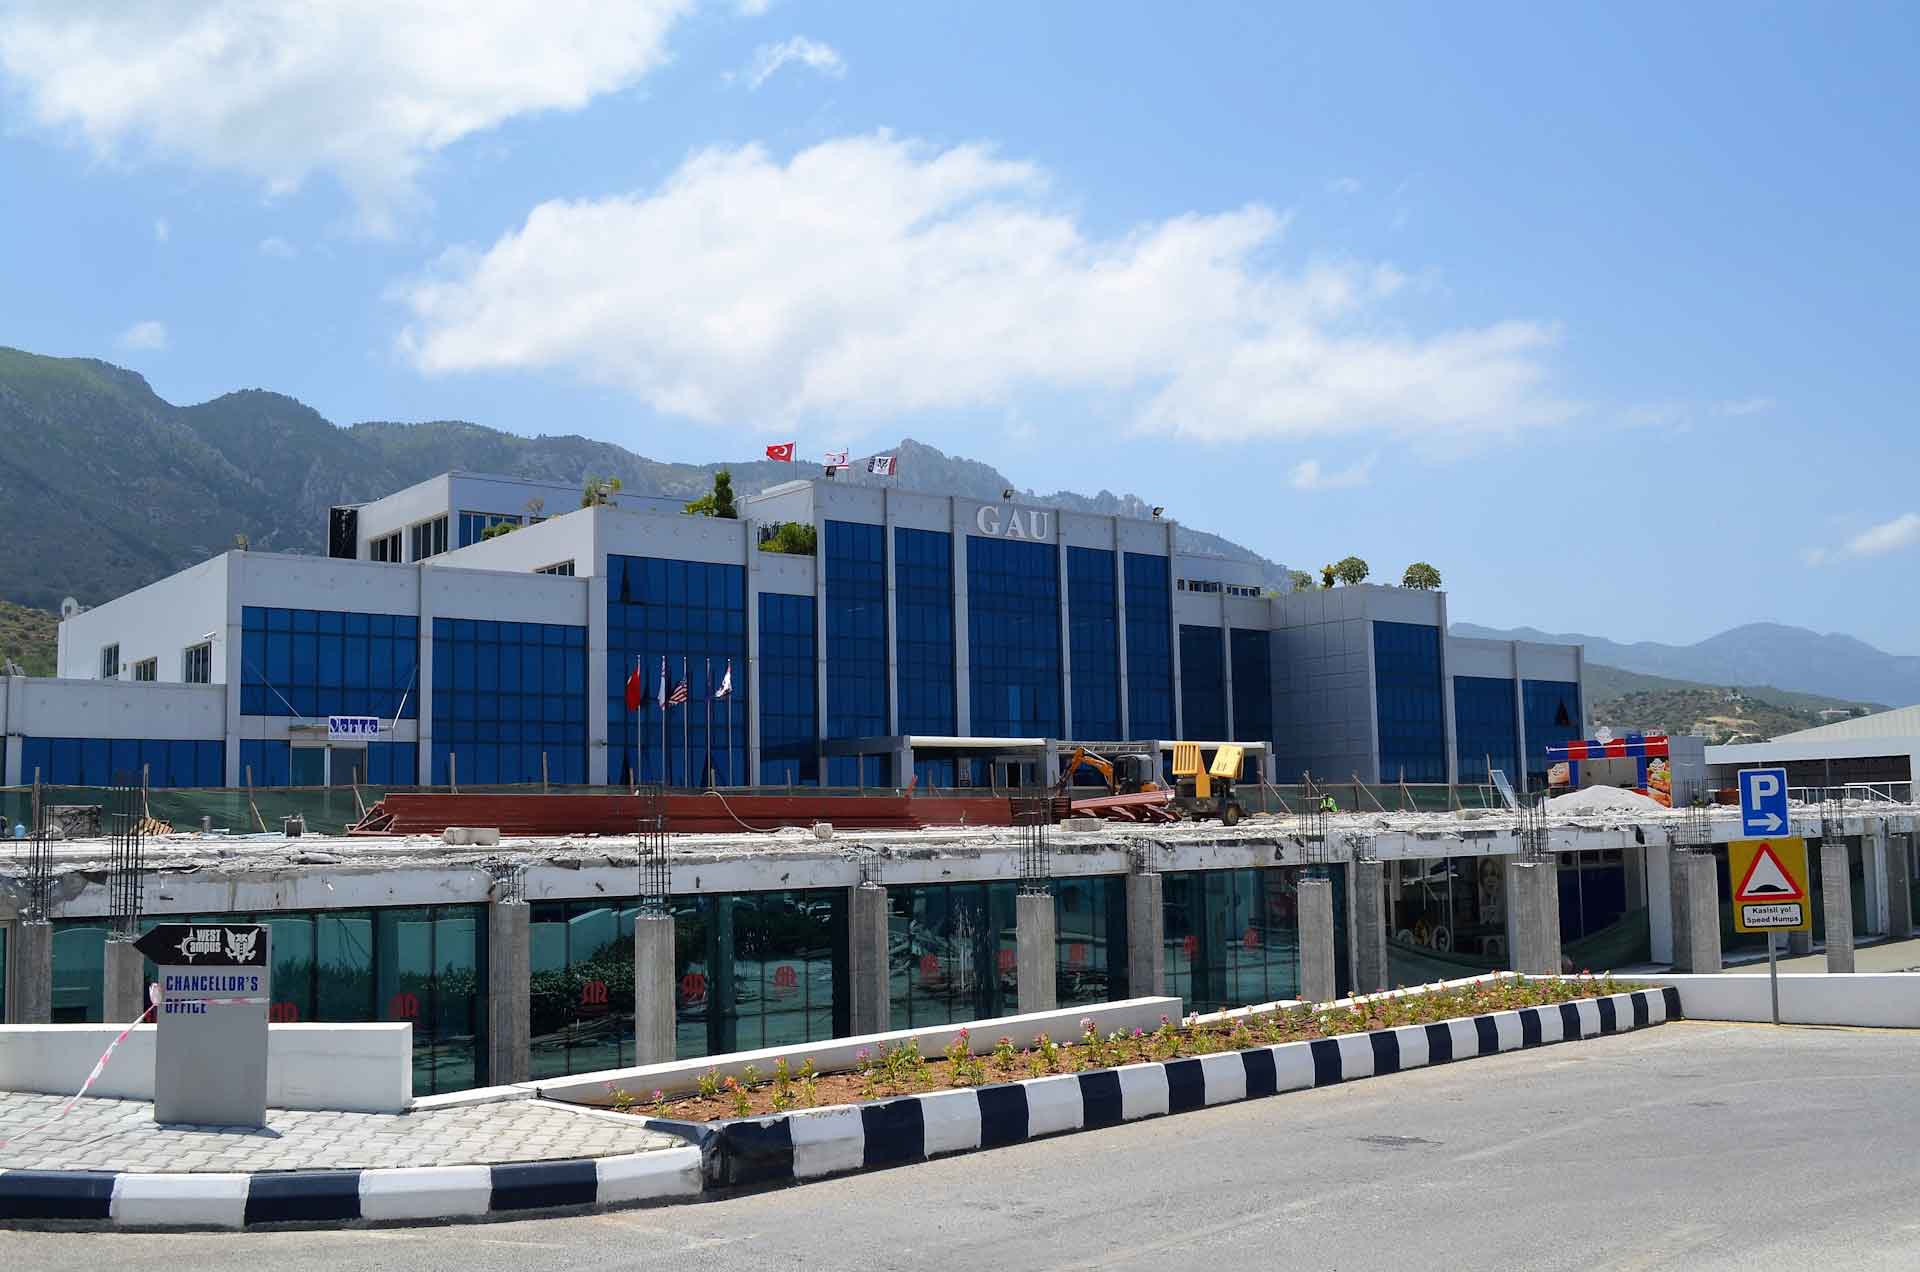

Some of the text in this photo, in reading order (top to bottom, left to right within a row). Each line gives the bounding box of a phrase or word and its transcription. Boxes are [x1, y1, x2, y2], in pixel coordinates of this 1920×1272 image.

[977, 506, 1048, 540] GAU
[1751, 774, 1779, 811] P
[1746, 916, 1770, 924] Speed
[196, 929, 221, 942] WEST
[166, 975, 259, 991] CHANCELLOR'S
[165, 998, 207, 1014] OFFICE
